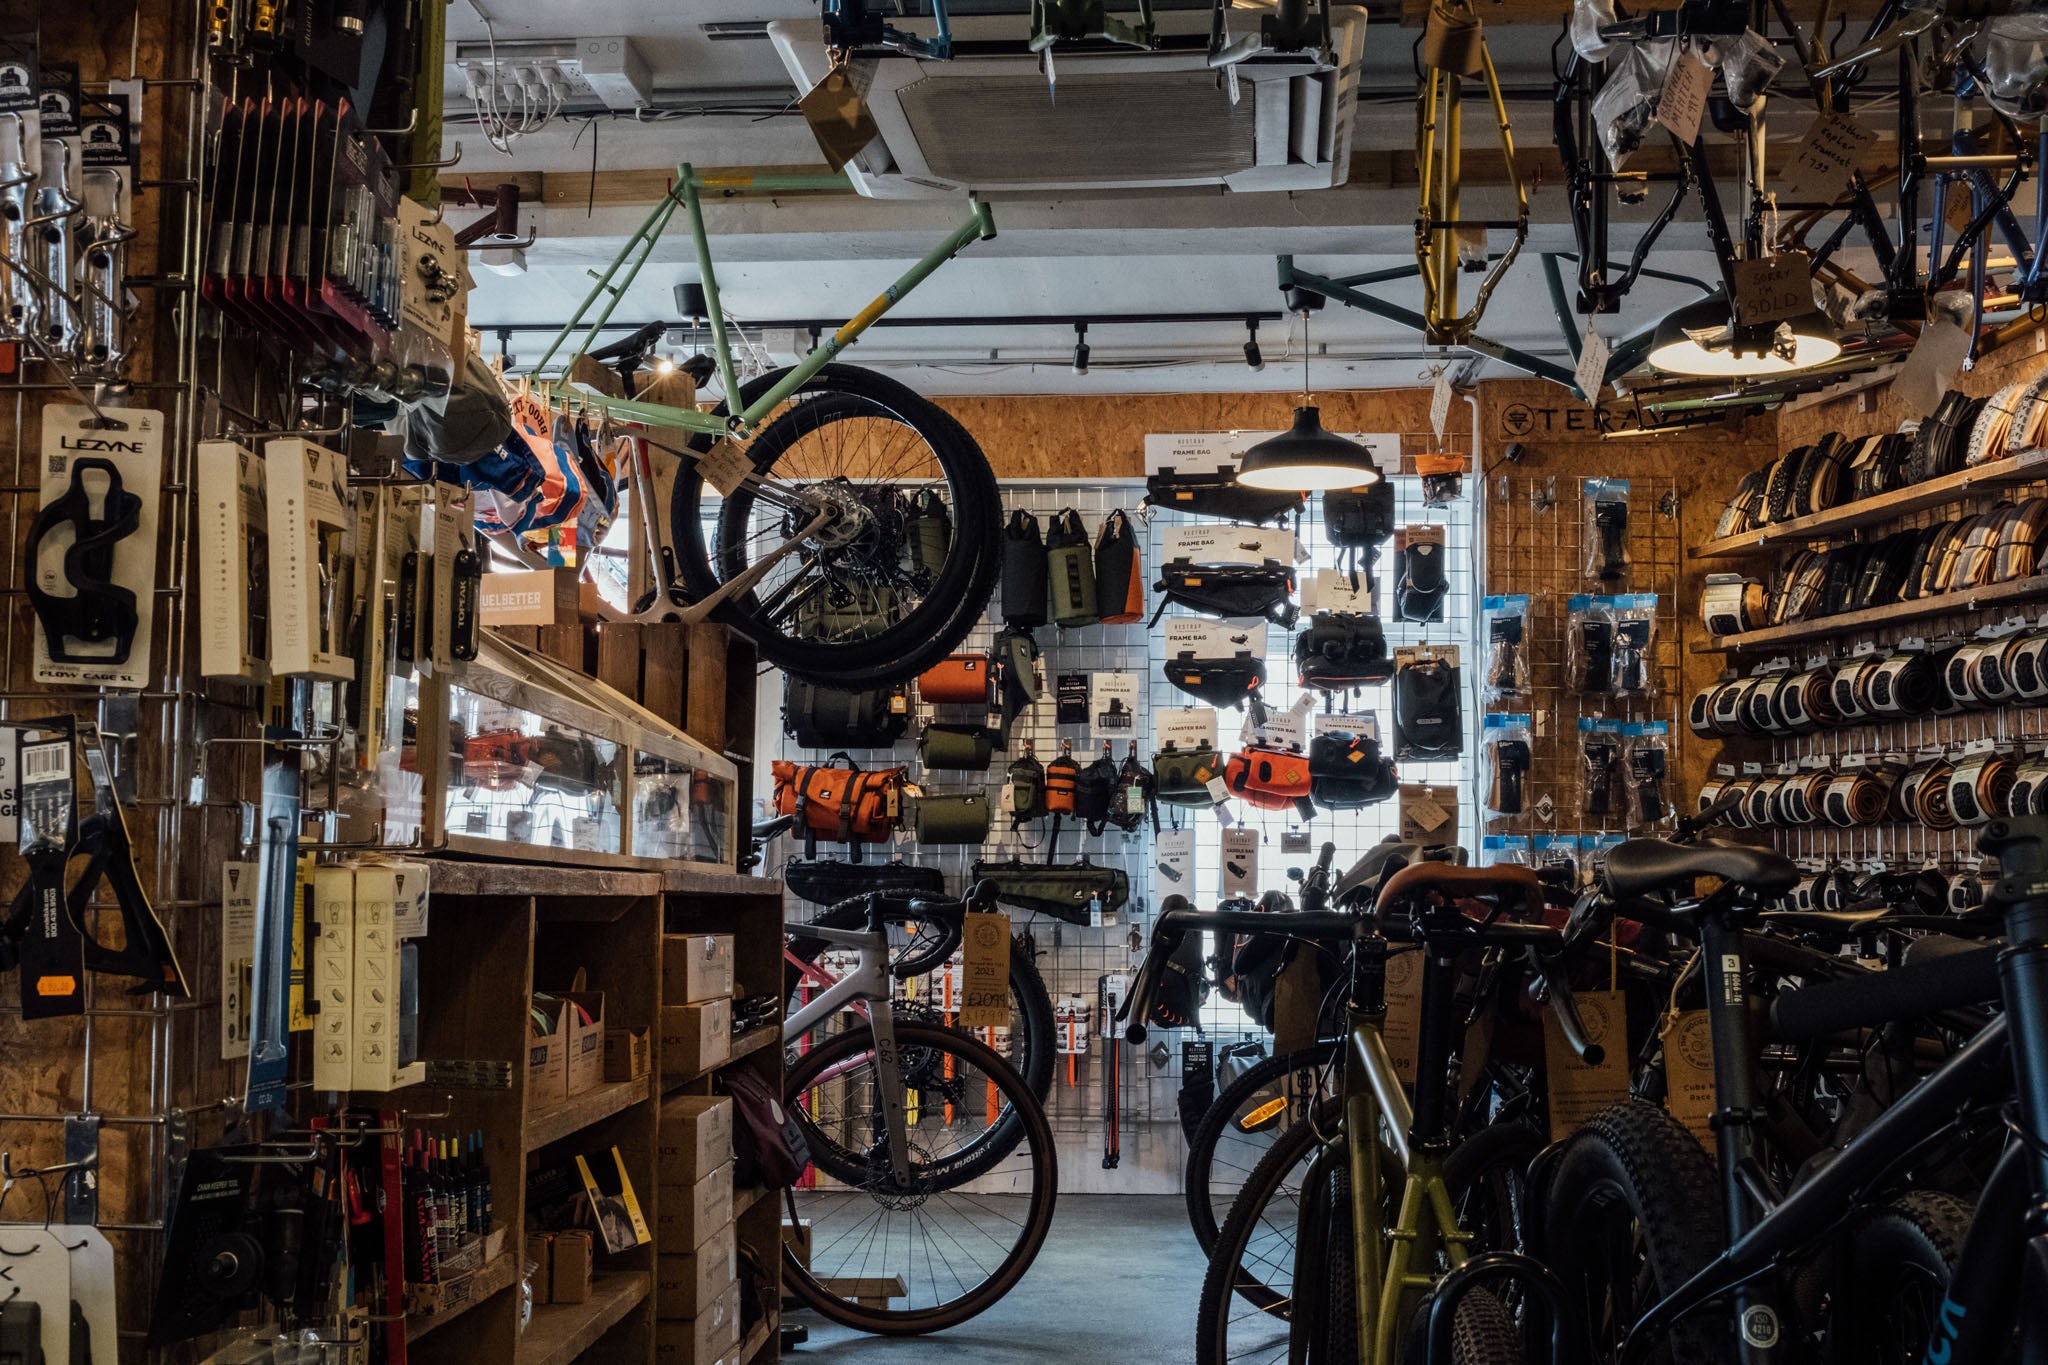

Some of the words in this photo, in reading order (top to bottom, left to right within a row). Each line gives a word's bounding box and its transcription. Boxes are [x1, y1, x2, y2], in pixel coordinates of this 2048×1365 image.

[412, 224, 447, 255] LEZYNE
[1747, 293, 1799, 318] SOLD
[61, 435, 144, 454] LEZYNE
[457, 580, 467, 629] TOPEAK
[481, 591, 541, 607] UELBETTER
[39, 670, 79, 678] FLOW
[83, 672, 118, 681] CAGE
[1754, 1313, 1770, 1324] ISO
